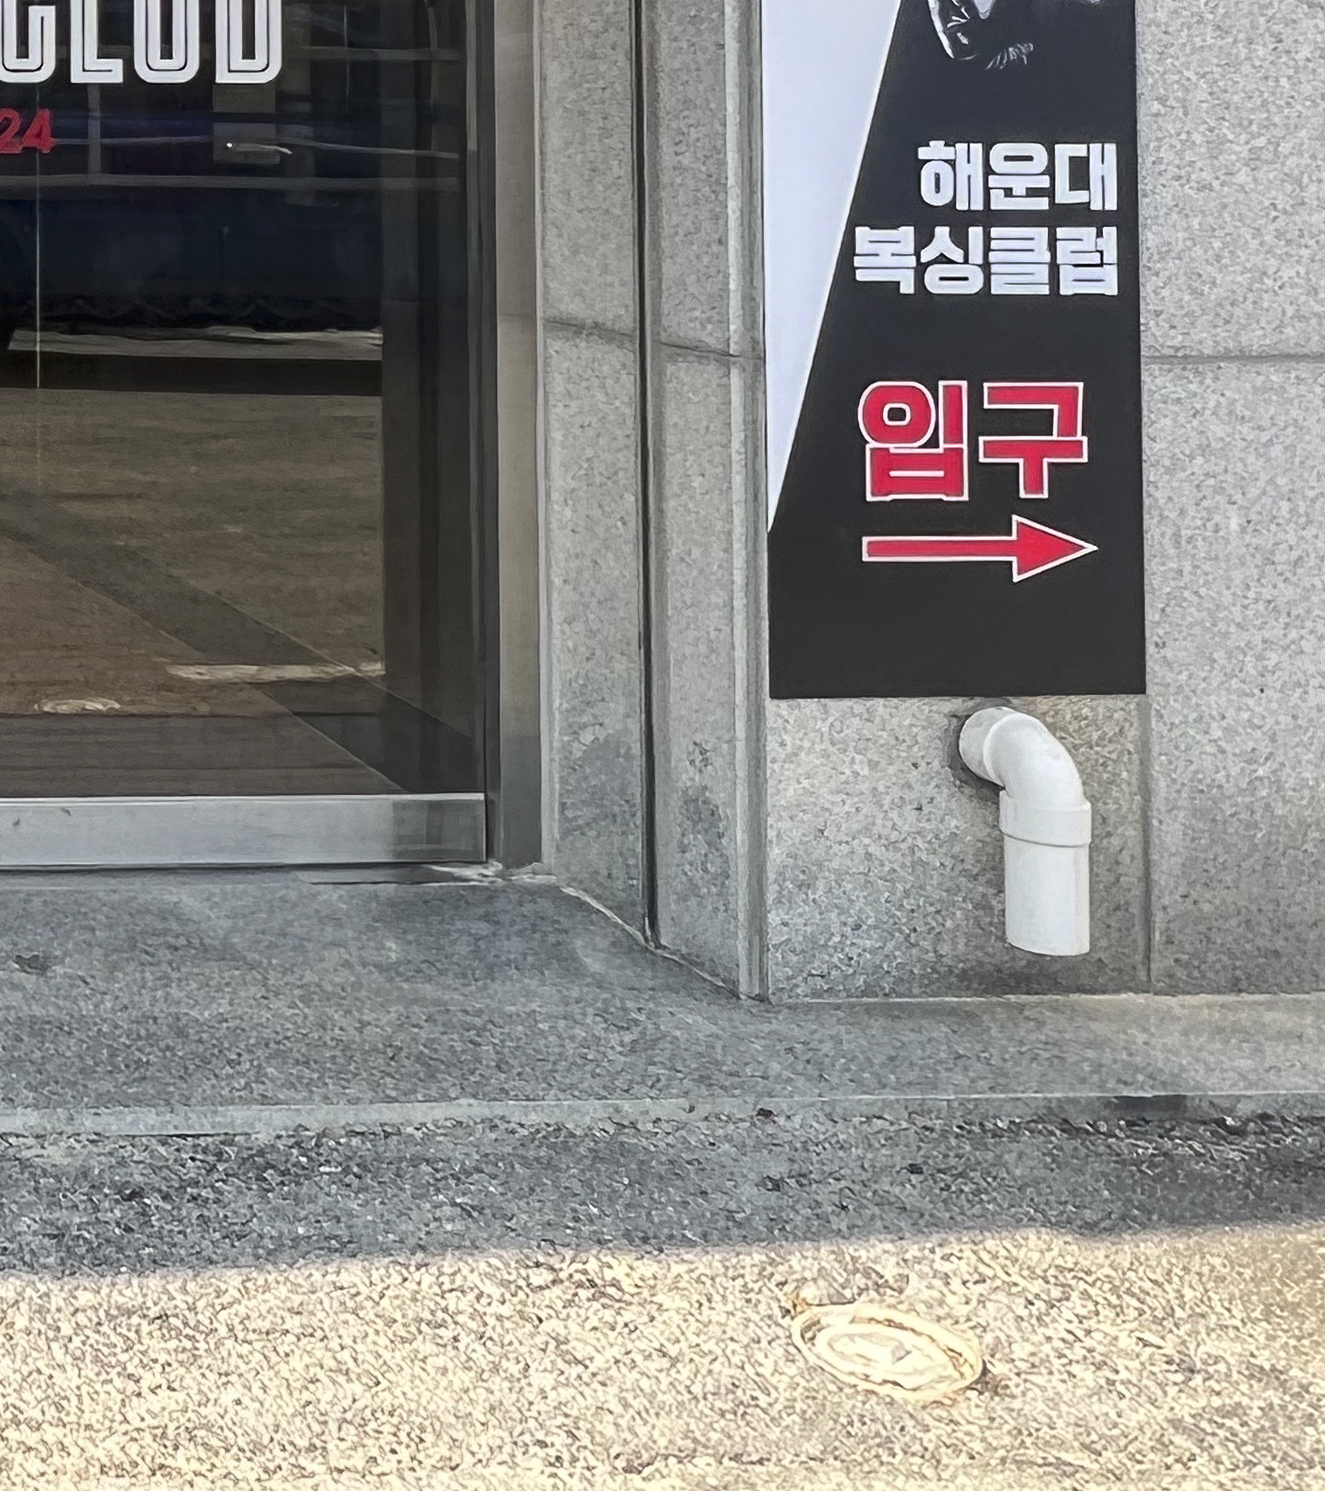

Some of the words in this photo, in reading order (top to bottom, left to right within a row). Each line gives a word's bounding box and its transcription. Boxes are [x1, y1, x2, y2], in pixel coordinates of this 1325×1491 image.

[917, 139, 1118, 211] 해운대
[852, 226, 1119, 296] 복싱클럽
[857, 379, 1089, 502] 입구
